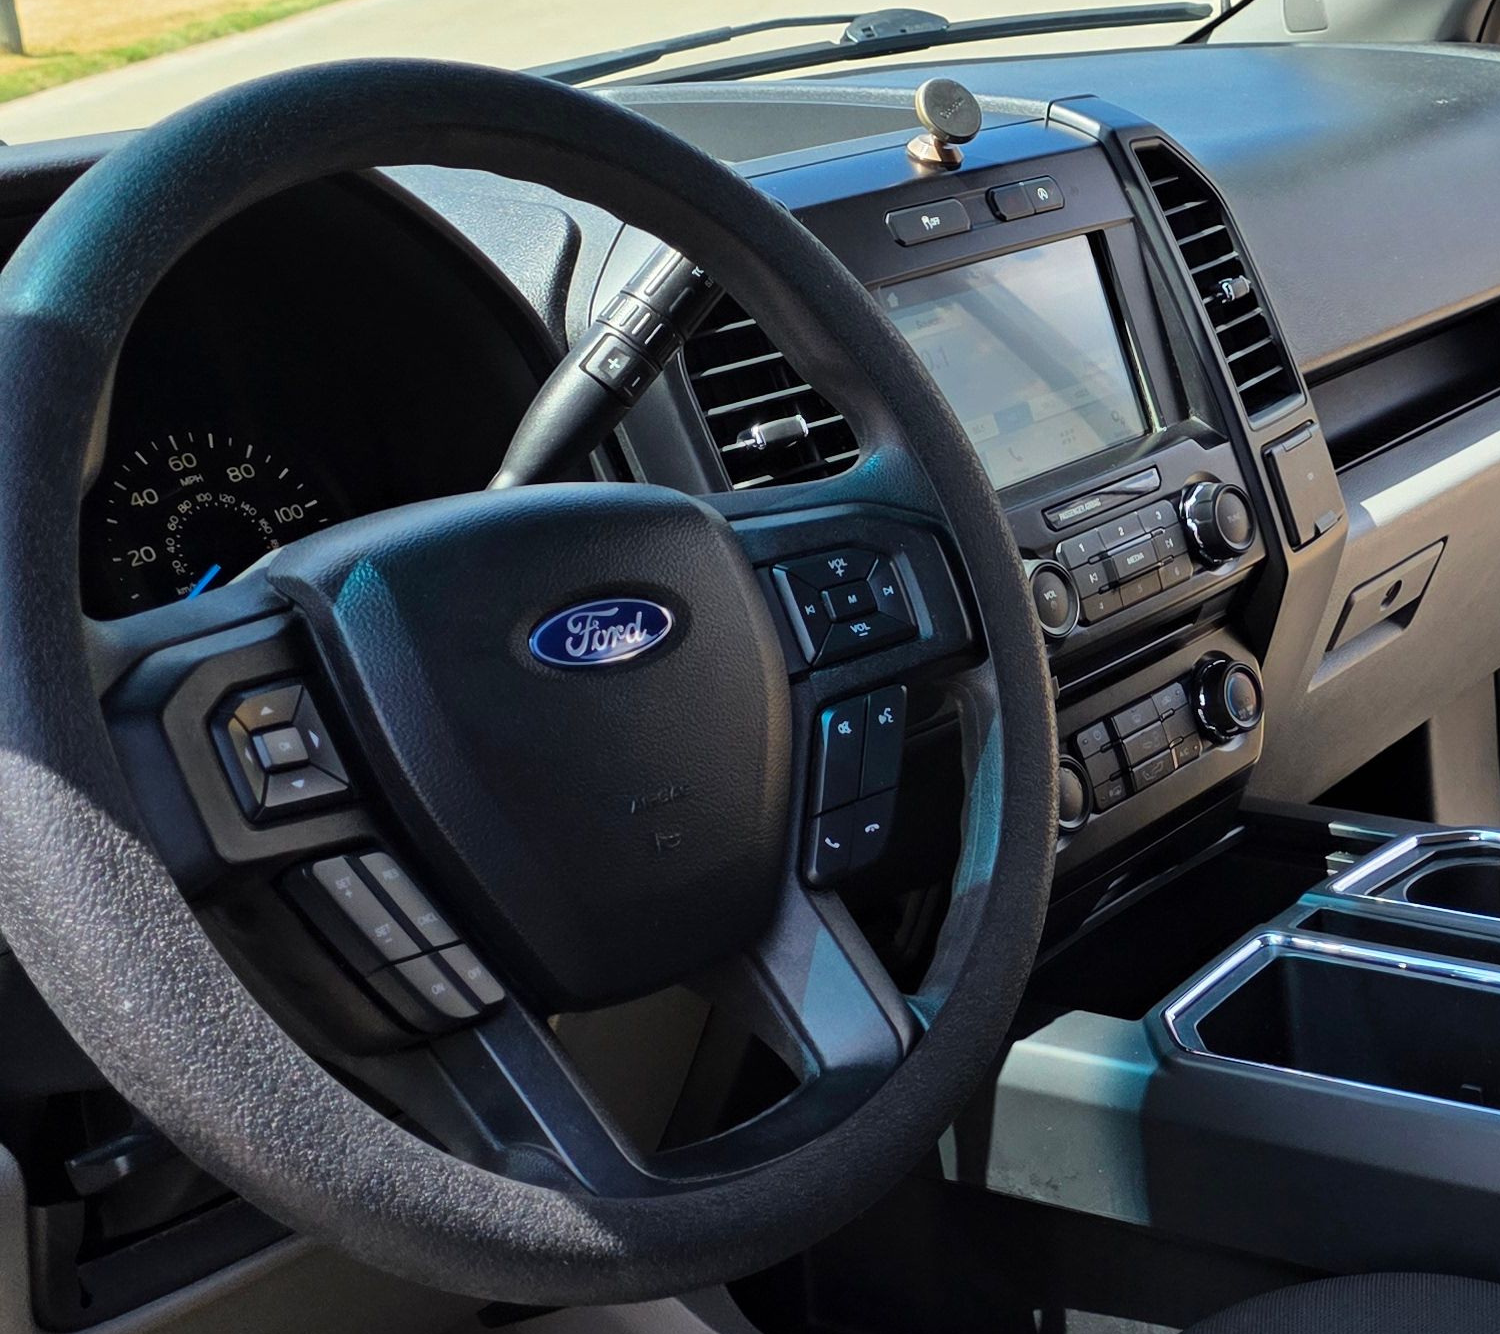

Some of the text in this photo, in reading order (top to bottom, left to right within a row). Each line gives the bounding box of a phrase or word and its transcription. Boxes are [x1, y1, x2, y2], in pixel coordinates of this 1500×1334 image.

[168, 452, 197, 471] 60
[226, 463, 255, 482] 80
[180, 474, 204, 487] MPH
[130, 488, 159, 507] 40
[196, 492, 212, 502] 100
[219, 493, 236, 504] 120
[177, 500, 192, 514] 80
[240, 502, 257, 516] 140
[275, 504, 304, 524] 100
[167, 515, 179, 531] 60
[1118, 526, 1125, 536] 2
[165, 538, 175, 553] 40
[1078, 543, 1085, 553] 1
[127, 546, 156, 567] 20
[827, 558, 848, 569] VOL
[1126, 552, 1145, 566] MEDIA
[172, 560, 185, 575] 20
[1043, 589, 1057, 601] VOL
[565, 606, 648, 657] Ford
[850, 622, 871, 634] VOL
[335, 876, 352, 890] SET
[374, 924, 390, 938] SET
[431, 982, 446, 995] ON
